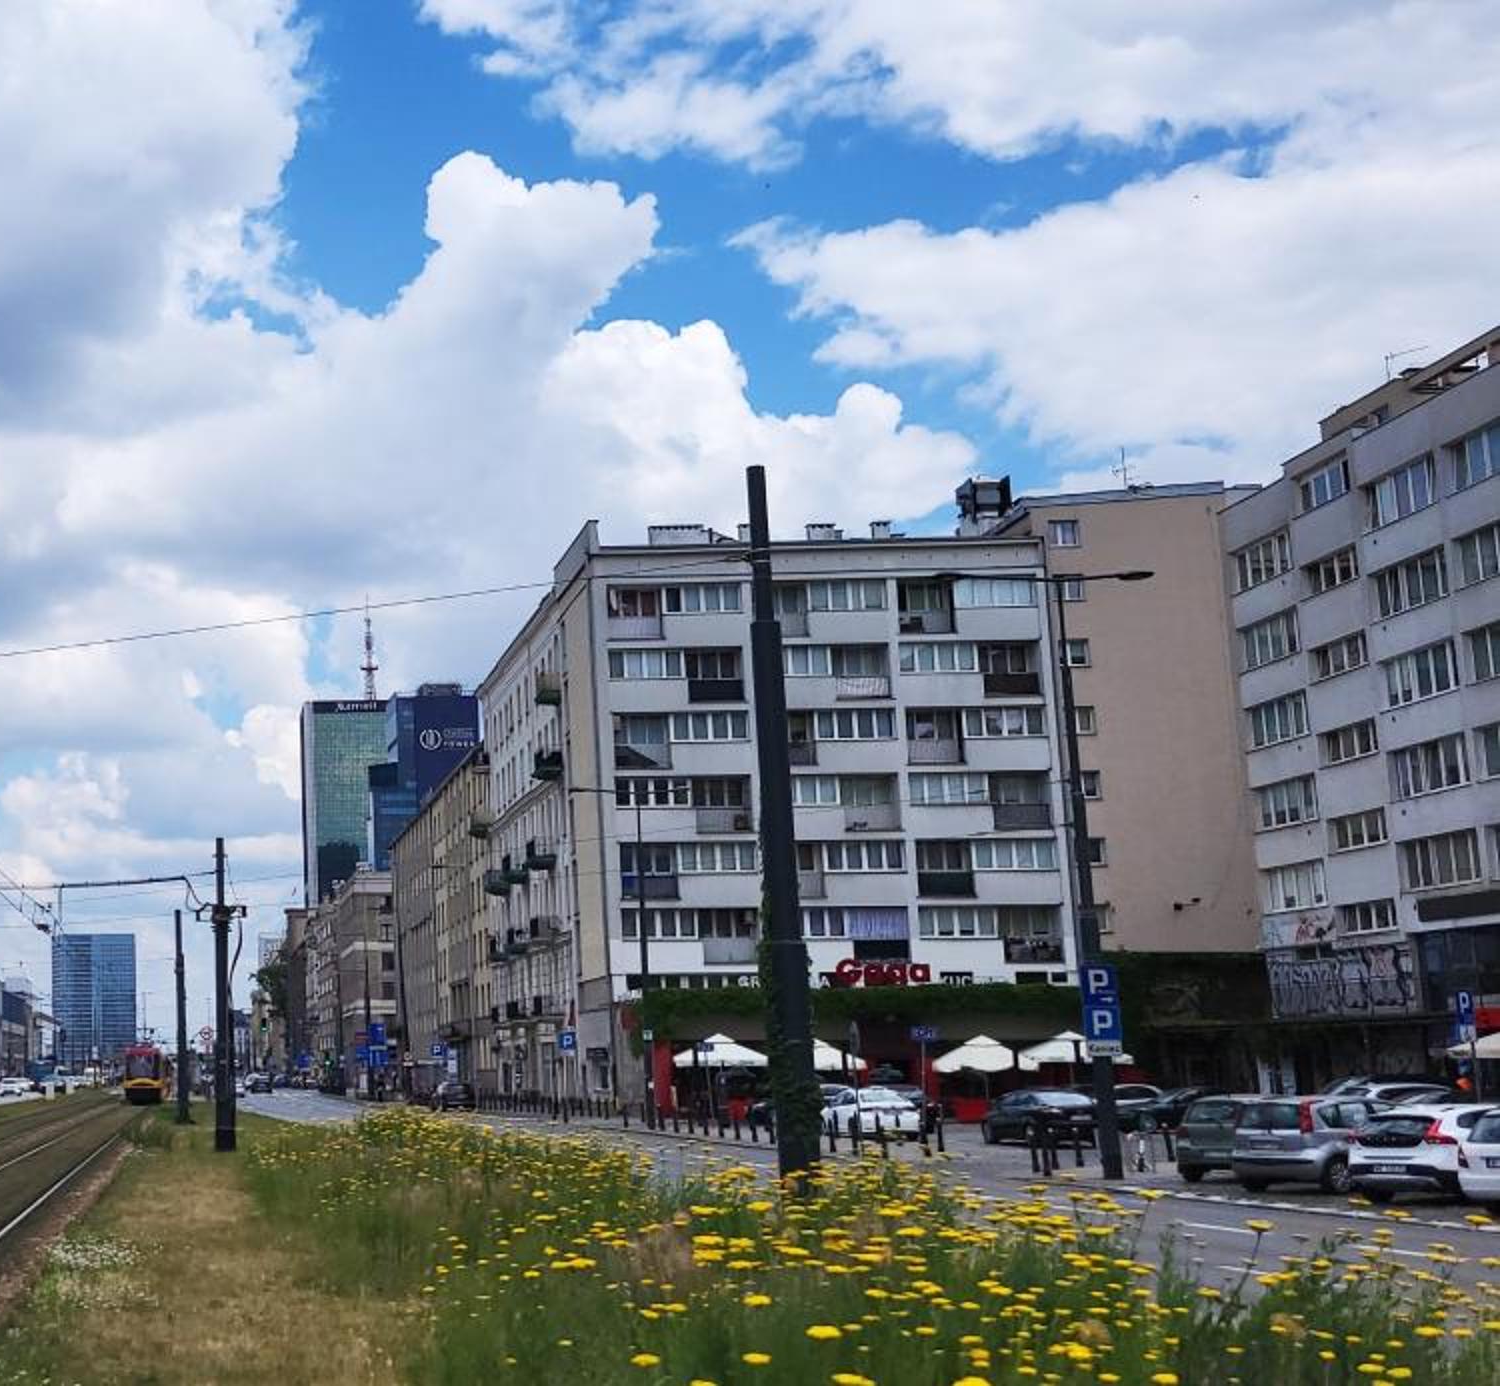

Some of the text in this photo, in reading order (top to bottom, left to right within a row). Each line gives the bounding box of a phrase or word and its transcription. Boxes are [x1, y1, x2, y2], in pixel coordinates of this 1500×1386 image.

[1088, 969, 1109, 994] P
[1459, 991, 1471, 1013] P
[1092, 1009, 1113, 1035] P
[433, 1045, 442, 1054] P
[563, 1035, 574, 1048] P
